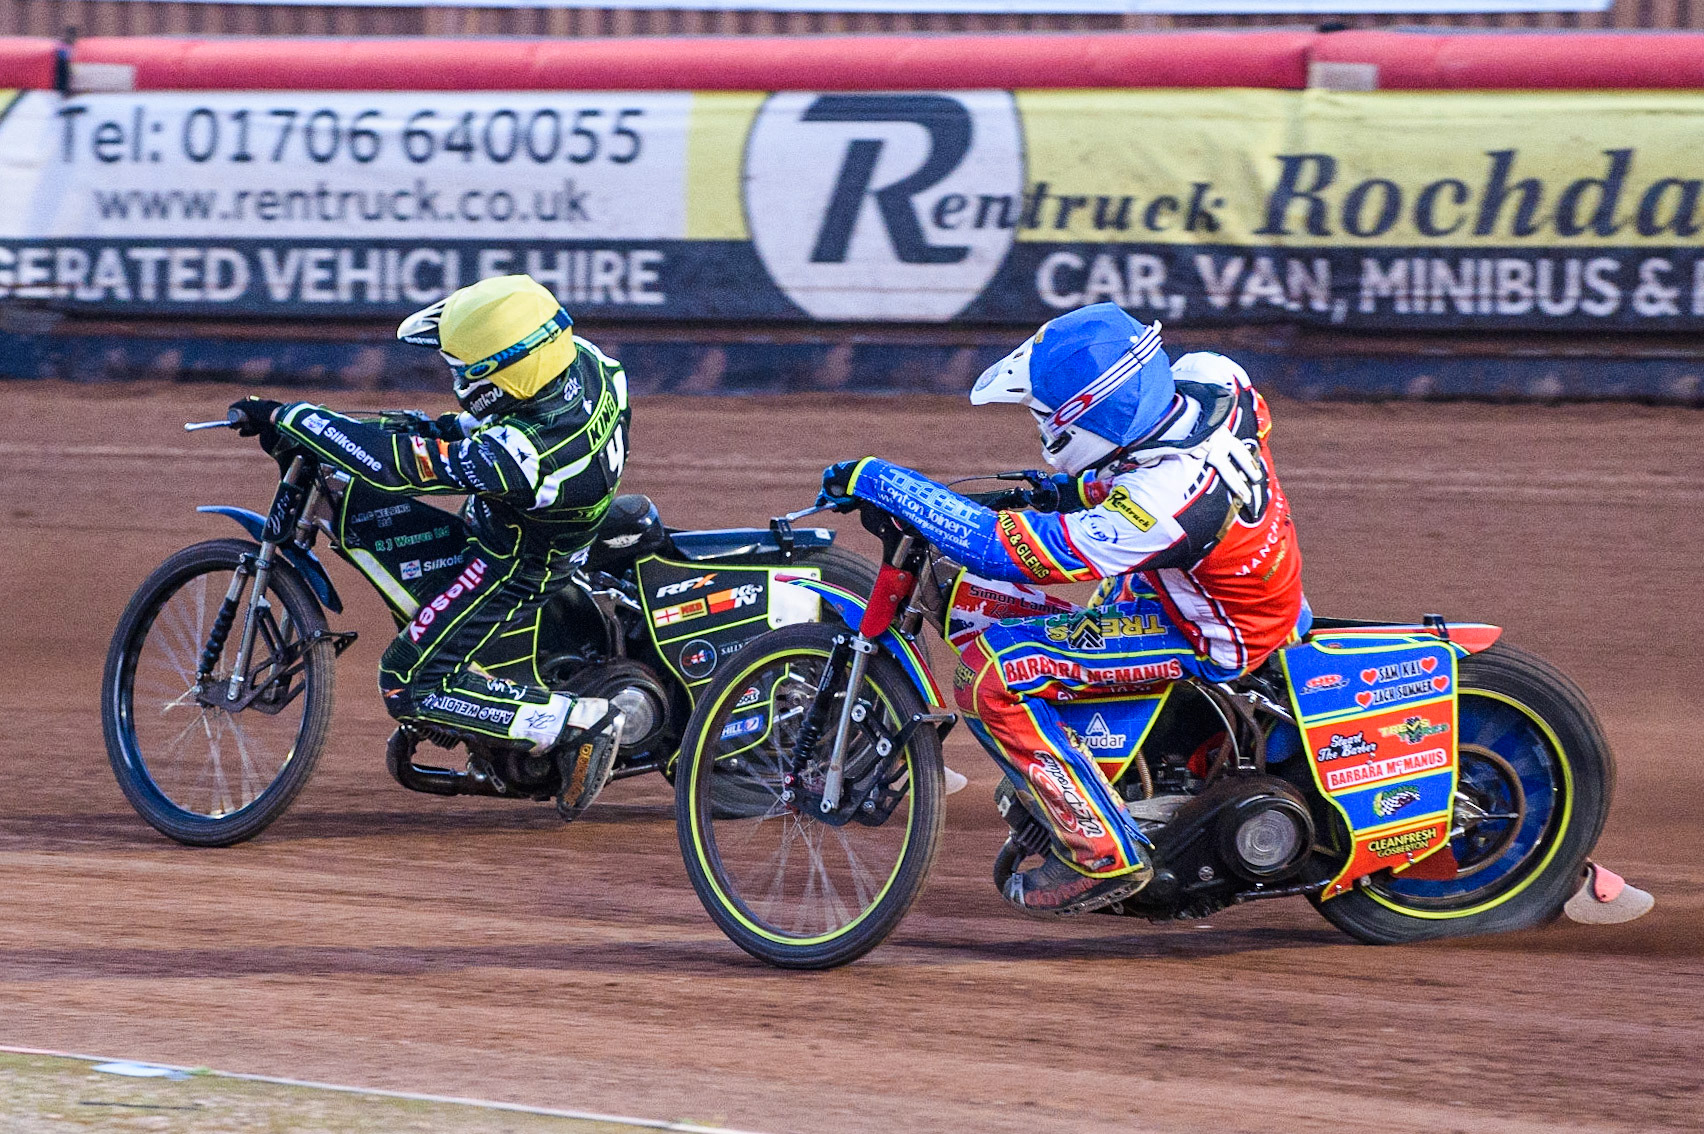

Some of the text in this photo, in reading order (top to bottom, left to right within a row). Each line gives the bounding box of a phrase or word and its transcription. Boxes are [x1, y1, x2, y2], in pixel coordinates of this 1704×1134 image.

[56, 106, 644, 164] Tel: 01706 640055
[96, 179, 592, 223] www.rentruck.co.uk
[526, 247, 665, 303] HIRE
[1036, 251, 1186, 320] CAR,
[1195, 252, 1349, 323] VAN,
[1360, 256, 1621, 316] MINIBUS
[1632, 256, 1680, 315] &
[322, 425, 384, 473] Silkolene
[926, 507, 973, 539] Joinery
[1106, 488, 1151, 531] Rentruck
[656, 573, 719, 598] RFX
[969, 585, 1018, 606] Simon
[1378, 661, 1421, 682] SAM KAI
[1397, 680, 1433, 699] SUMMER
[1317, 747, 1338, 762] The
[1330, 764, 1384, 788] BARBARA
[1367, 828, 1438, 853] CLEANFRESH
